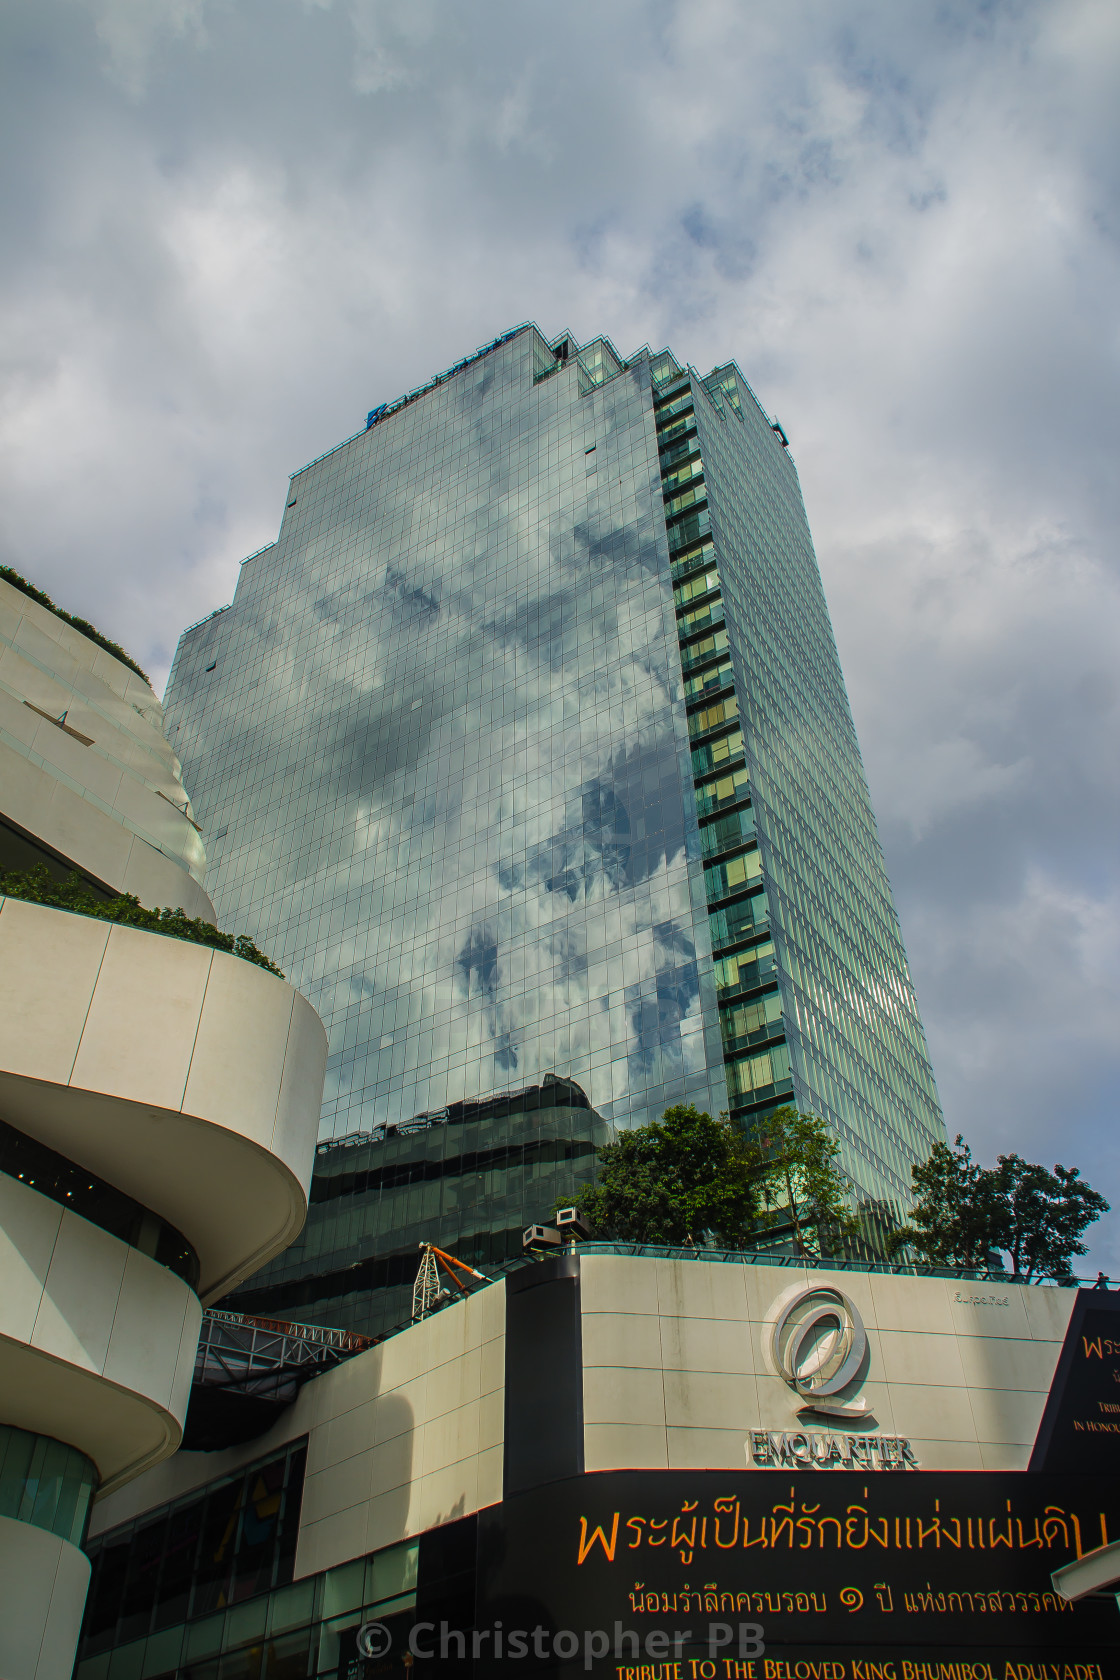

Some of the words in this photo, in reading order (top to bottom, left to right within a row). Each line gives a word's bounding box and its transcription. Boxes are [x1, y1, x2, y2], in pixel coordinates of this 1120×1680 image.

[1073, 1420, 1085, 1432] IN
[750, 1430, 920, 1464] EMQUARTIER
[873, 1582, 894, 1613] ปี
[615, 1661, 684, 1680] TRIBUTE
[688, 1658, 716, 1680] TO
[722, 1658, 758, 1680] THE
[763, 1658, 846, 1680] BELOVED
[851, 1659, 897, 1680] KING
[901, 1660, 998, 1680] BHUMIBOL
